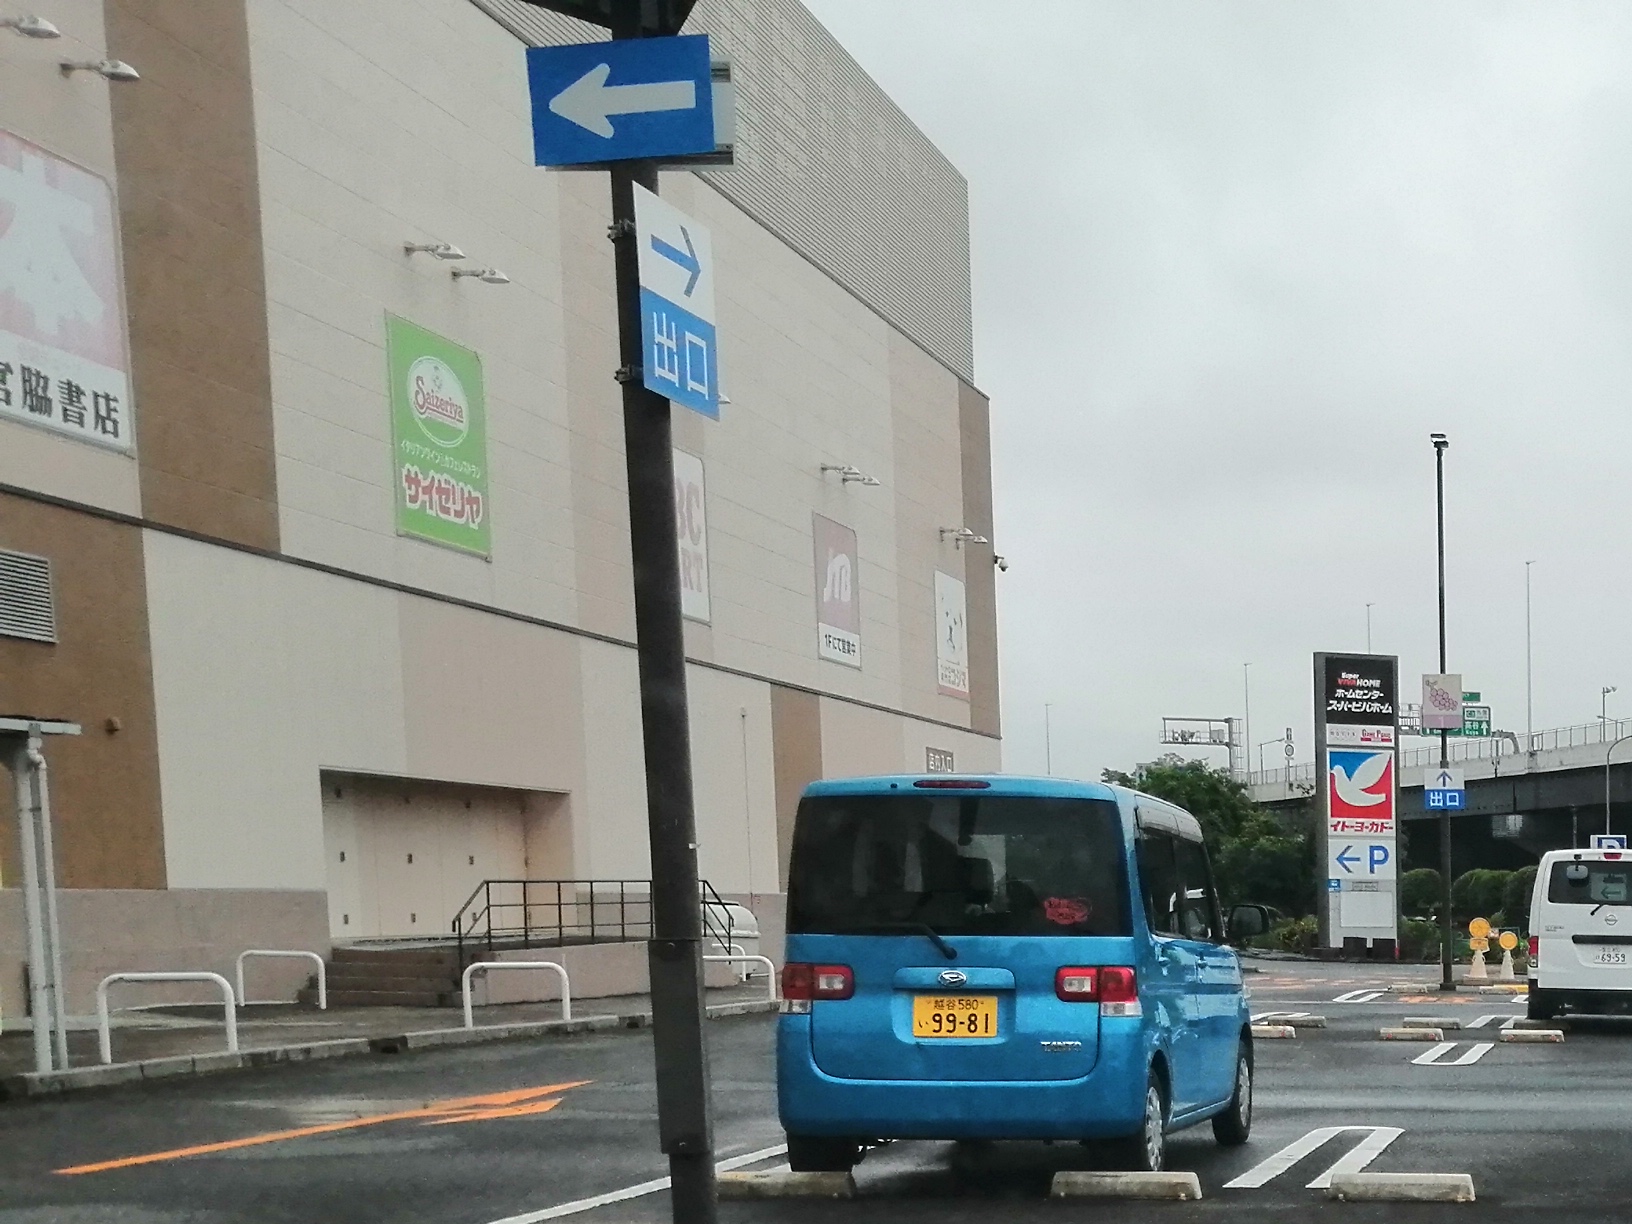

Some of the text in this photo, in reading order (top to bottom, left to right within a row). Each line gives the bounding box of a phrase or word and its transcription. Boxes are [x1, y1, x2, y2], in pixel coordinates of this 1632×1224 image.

[653, 311, 709, 400] 出口
[414, 375, 464, 423] Saizeriya
[404, 465, 482, 526] サイゼリヤ
[676, 476, 702, 546] BC
[1335, 689, 1384, 699] ホームセンター
[1430, 792, 1460, 807] 出口
[1330, 821, 1393, 833] イトーヨーカドー
[1369, 845, 1389, 874] P
[1601, 953, 1625, 962] 69-59
[934, 999, 979, 1010] 越谷 580
[932, 1013, 989, 1033] 99-81
